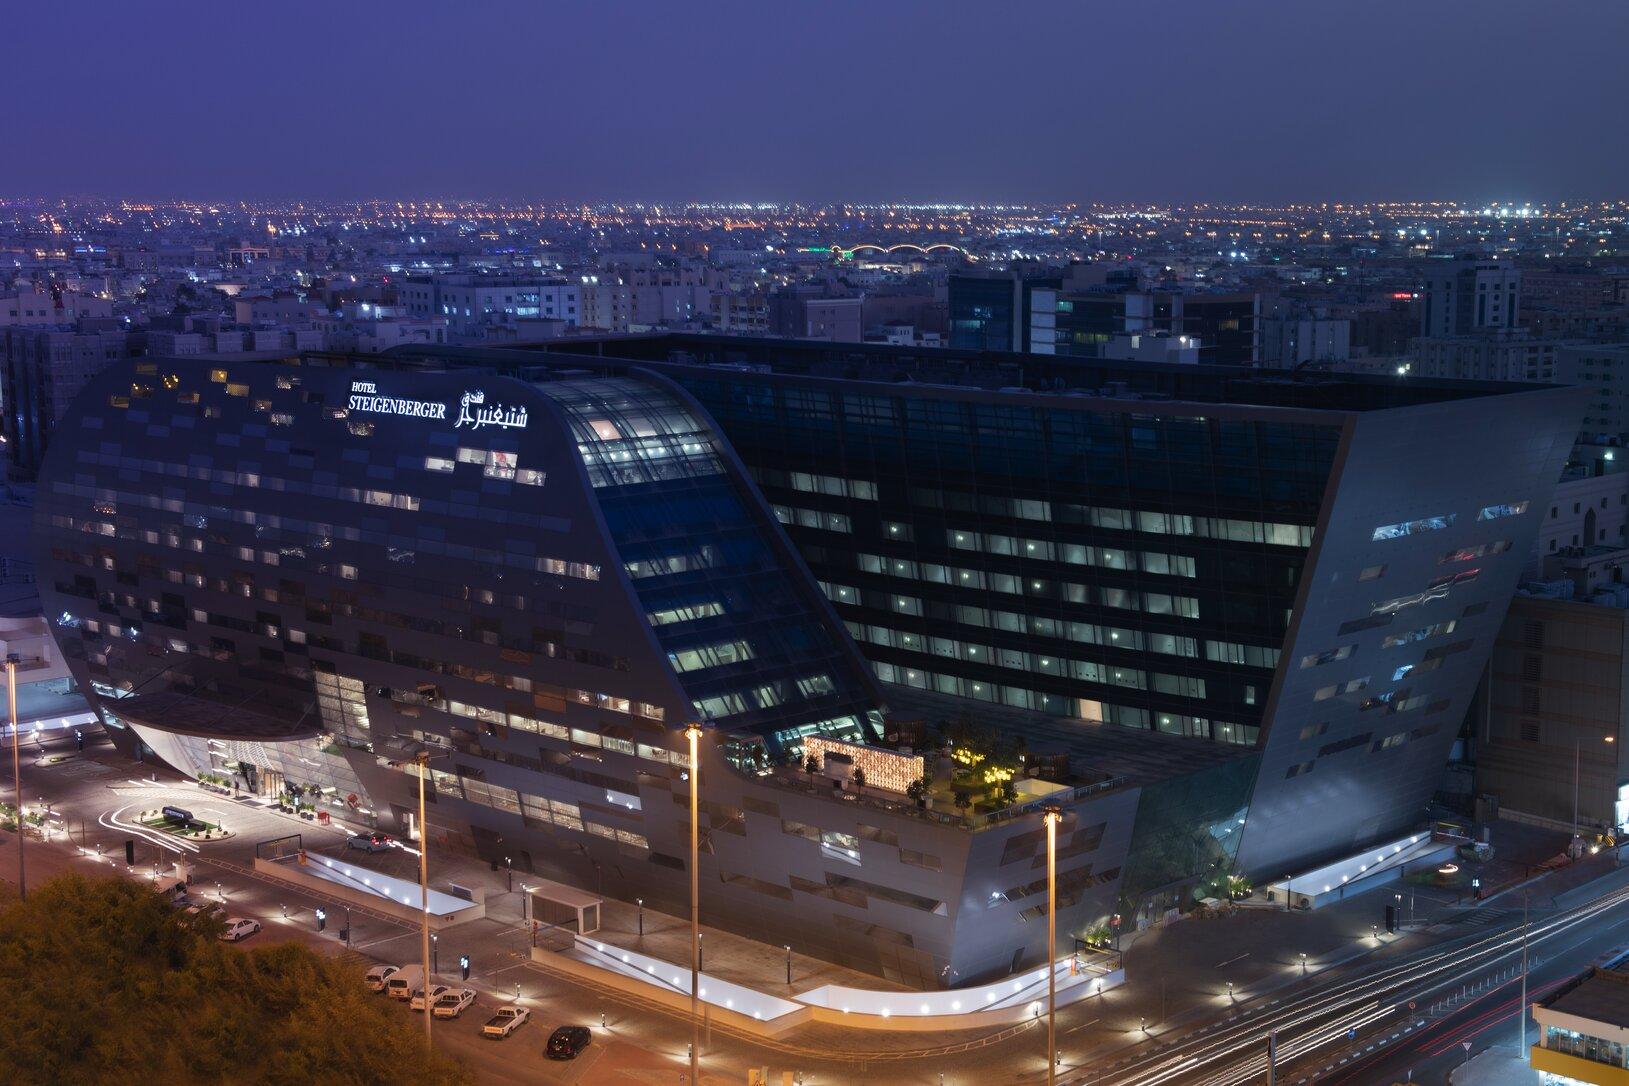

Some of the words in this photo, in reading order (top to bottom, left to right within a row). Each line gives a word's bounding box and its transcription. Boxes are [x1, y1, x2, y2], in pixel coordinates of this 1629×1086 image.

[351, 381, 377, 394] HOTEL
[461, 390, 485, 406] فندق
[348, 394, 446, 419] STEIGENBERGER
